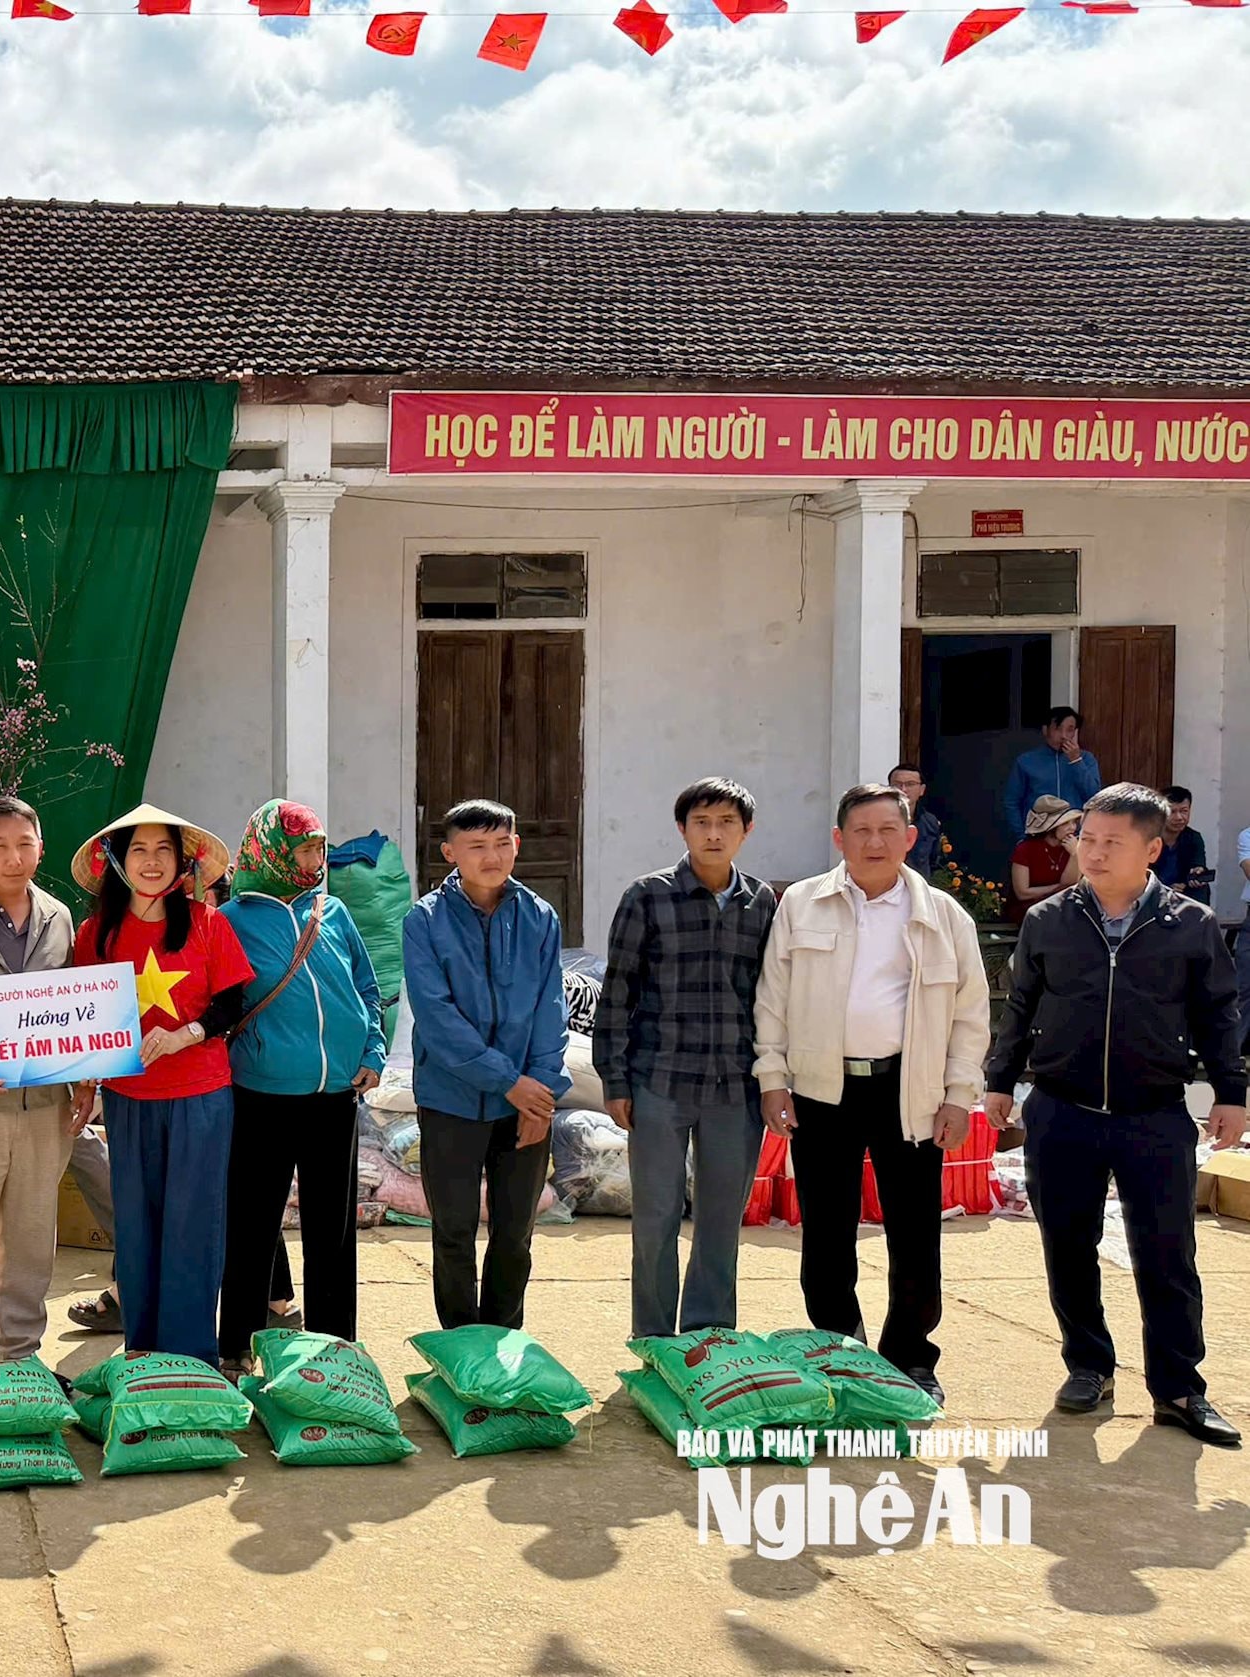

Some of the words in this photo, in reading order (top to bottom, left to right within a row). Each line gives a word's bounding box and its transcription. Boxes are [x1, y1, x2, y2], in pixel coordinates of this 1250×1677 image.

[425, 413, 498, 467] HỌC
[509, 397, 559, 458] ĐỂ
[567, 406, 645, 459] LÀM
[656, 406, 766, 460] NGƯỜI
[802, 408, 878, 460] LÀM
[889, 417, 958, 461] CHO
[969, 408, 1042, 461] DÂN
[1053, 410, 1143, 467] GIÀU,
[1154, 412, 1249, 463] NƯỚC
[25, 985, 54, 999] NGHỆ
[56, 985, 70, 995] AN
[73, 981, 82, 994] Ở
[84, 981, 98, 993] HÀ
[101, 978, 119, 992] NỘI
[17, 1009, 70, 1029] Hướng
[75, 1002, 95, 1021] Về
[24, 1034, 53, 1058] ẤM
[57, 1035, 84, 1054] NA
[88, 1030, 132, 1051] NGOI
